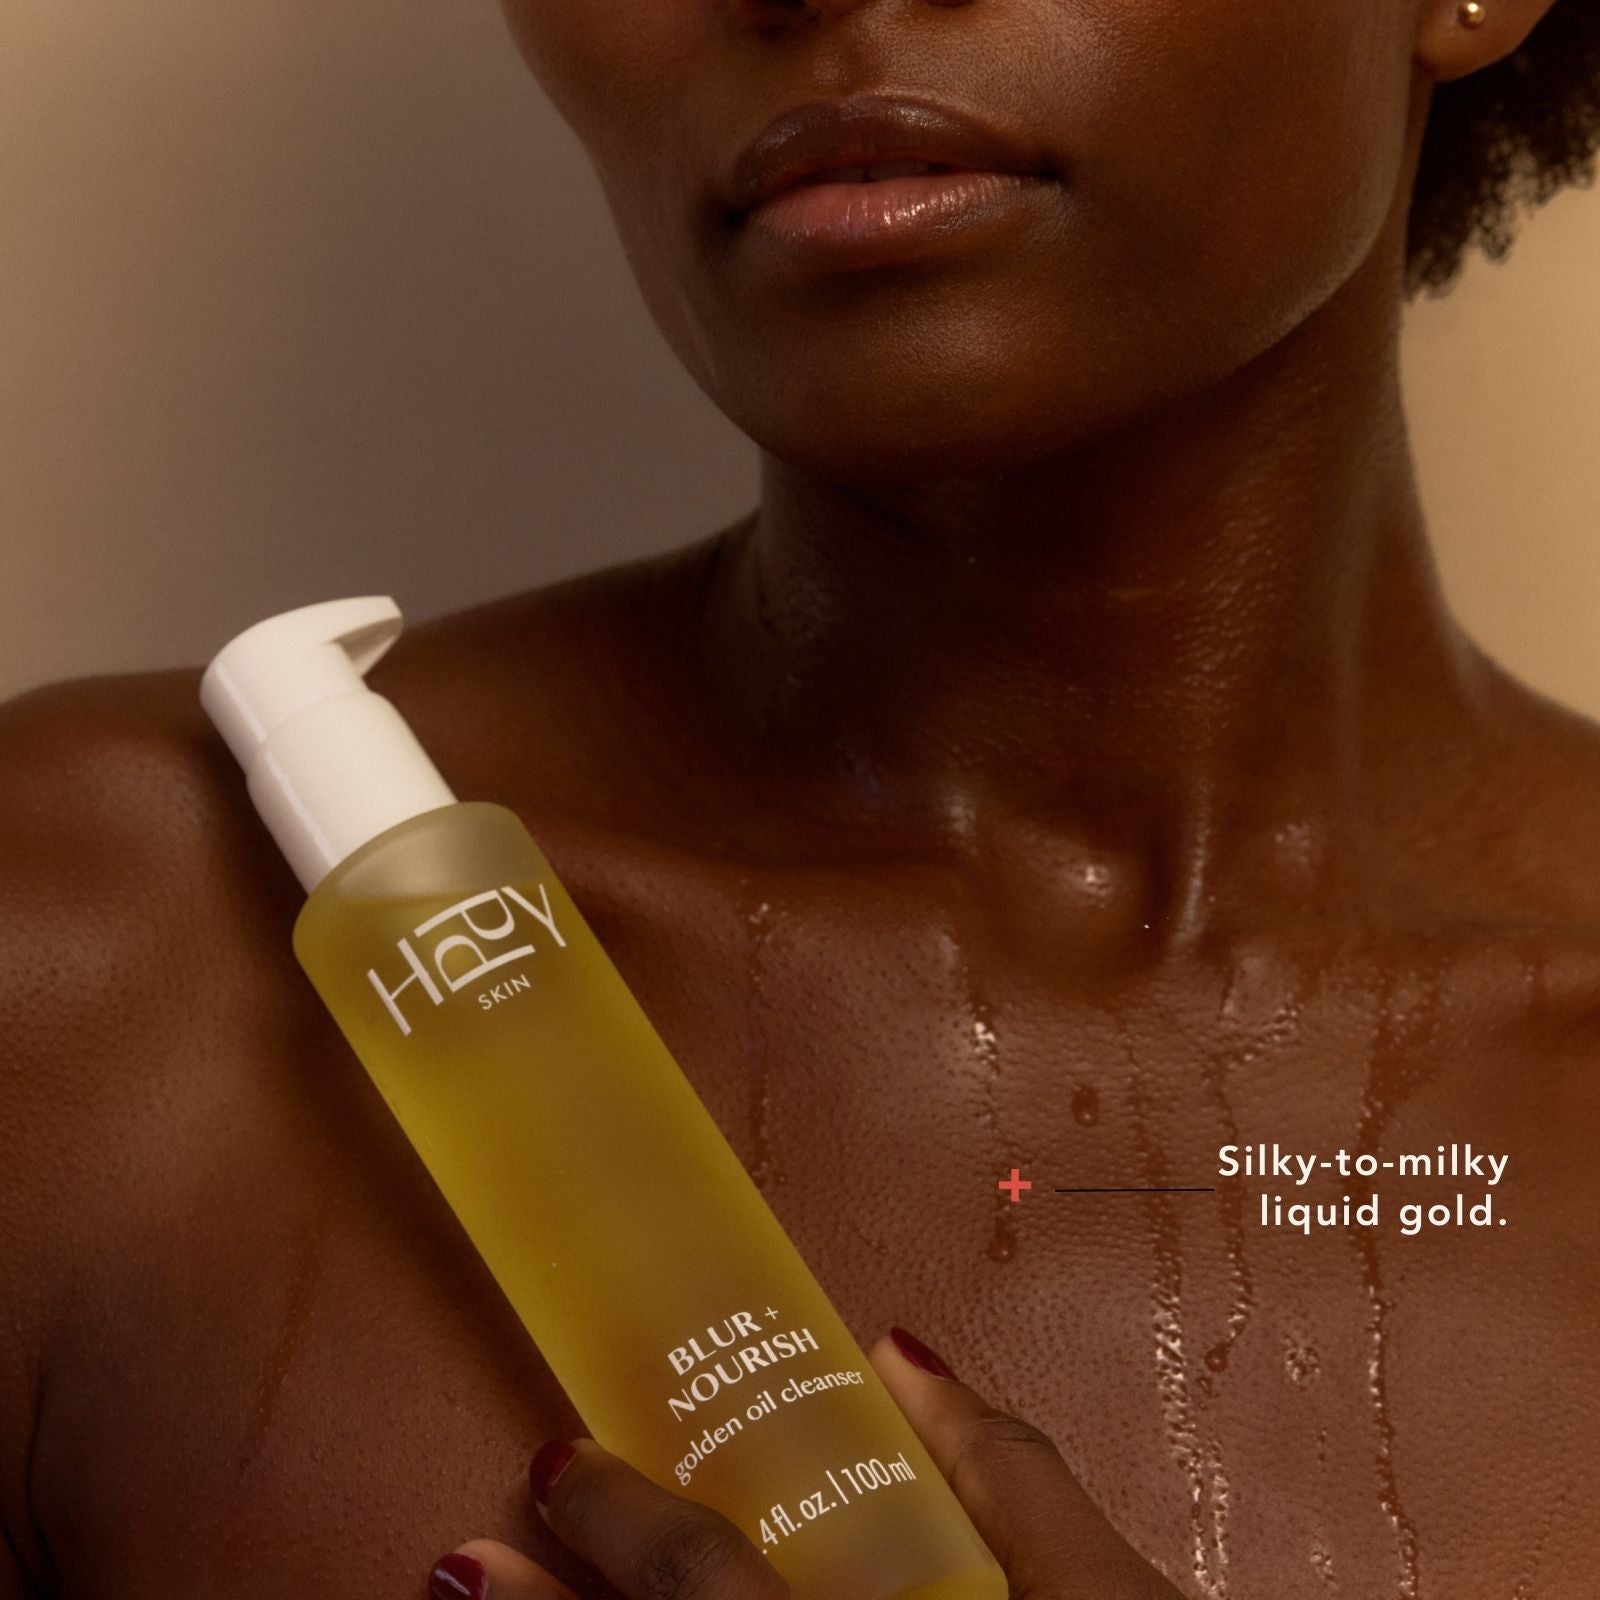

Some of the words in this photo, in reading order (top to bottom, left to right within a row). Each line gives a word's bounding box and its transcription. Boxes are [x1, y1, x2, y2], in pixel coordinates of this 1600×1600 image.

[478, 974, 532, 1011] SKIN
[667, 1310, 763, 1376] BLUR
[667, 1328, 820, 1422] NOURISH
[674, 1417, 744, 1486] golden
[746, 1390, 778, 1421] oil
[780, 1369, 864, 1403] cleanser
[760, 1517, 779, 1555] .4
